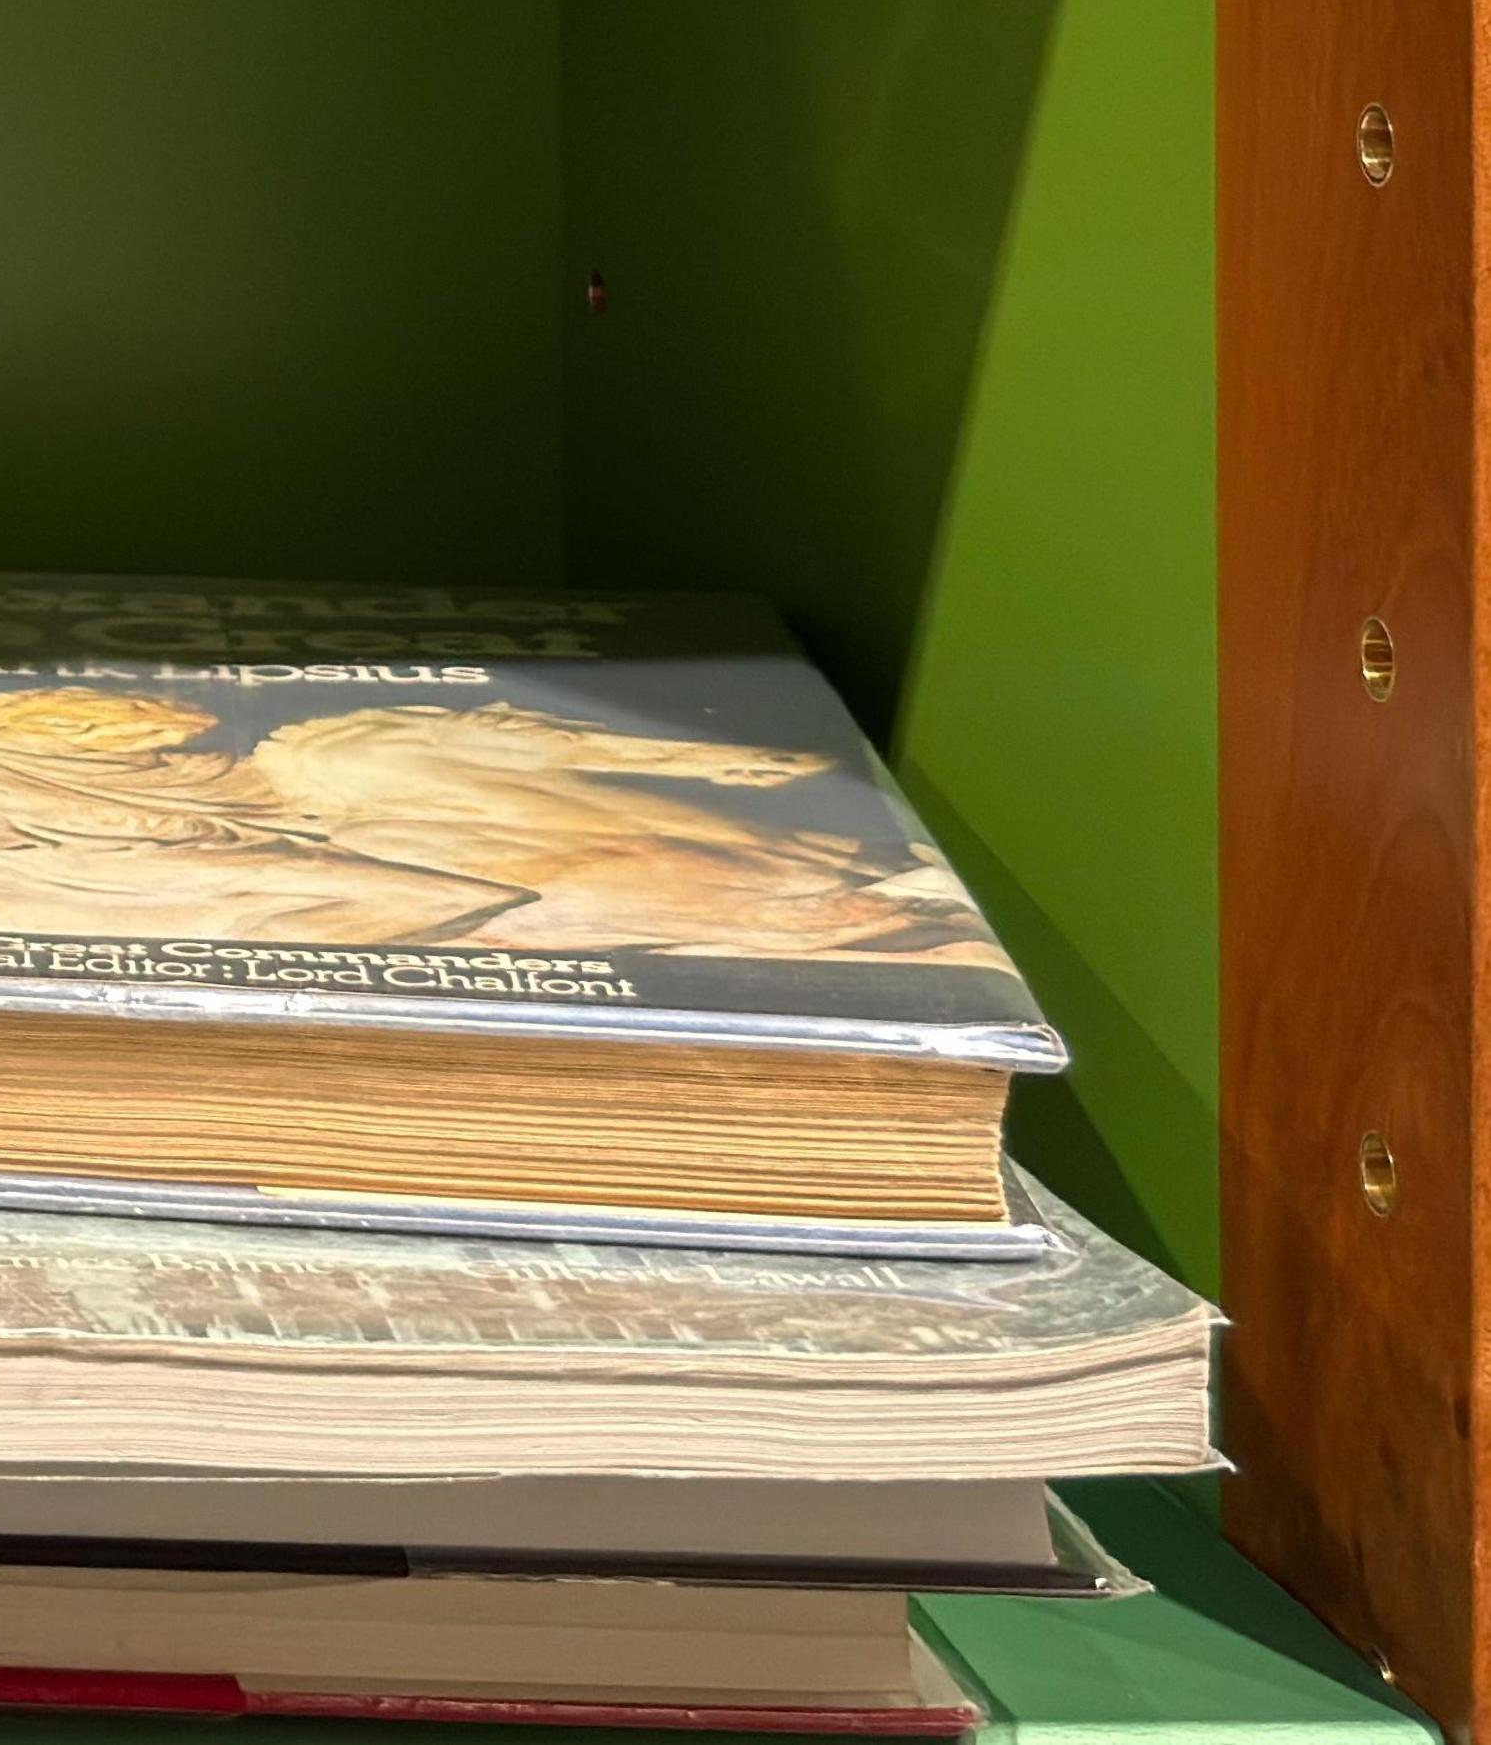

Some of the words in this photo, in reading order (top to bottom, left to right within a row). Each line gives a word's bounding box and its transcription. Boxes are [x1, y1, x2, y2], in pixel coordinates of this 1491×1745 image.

[152, 661, 493, 686] Lipsius
[160, 941, 615, 974] Commanders
[245, 959, 374, 985] Lord
[383, 966, 638, 997] Chalfont
